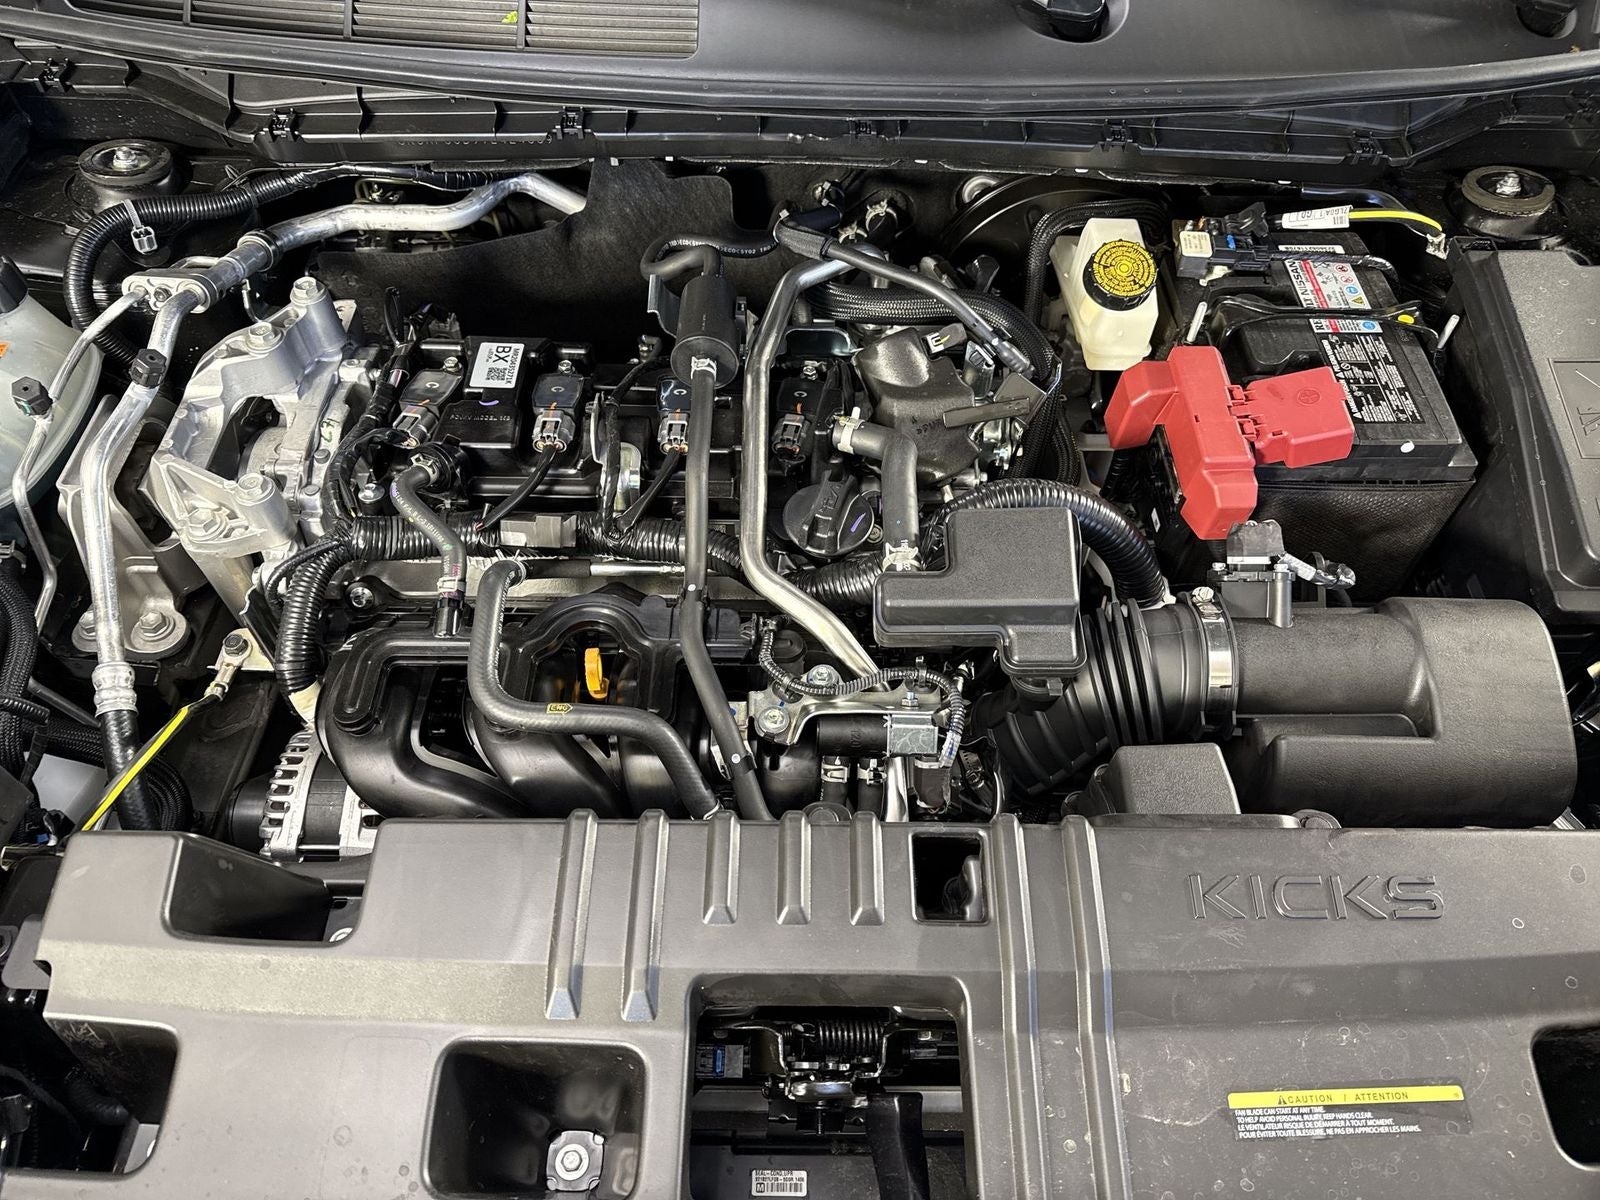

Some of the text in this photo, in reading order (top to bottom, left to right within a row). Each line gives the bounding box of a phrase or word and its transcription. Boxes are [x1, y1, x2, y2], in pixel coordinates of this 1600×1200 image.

[493, 345, 512, 363] BX
[1188, 874, 1444, 920] KICKS
[1287, 1094, 1333, 1104] CAUTION
[1355, 1092, 1409, 1101] ATTENTION
[1246, 1123, 1283, 1131] VENTILATEUR
[1277, 1130, 1296, 1138] TOUTE
[1355, 1126, 1389, 1134] APPROCHER
